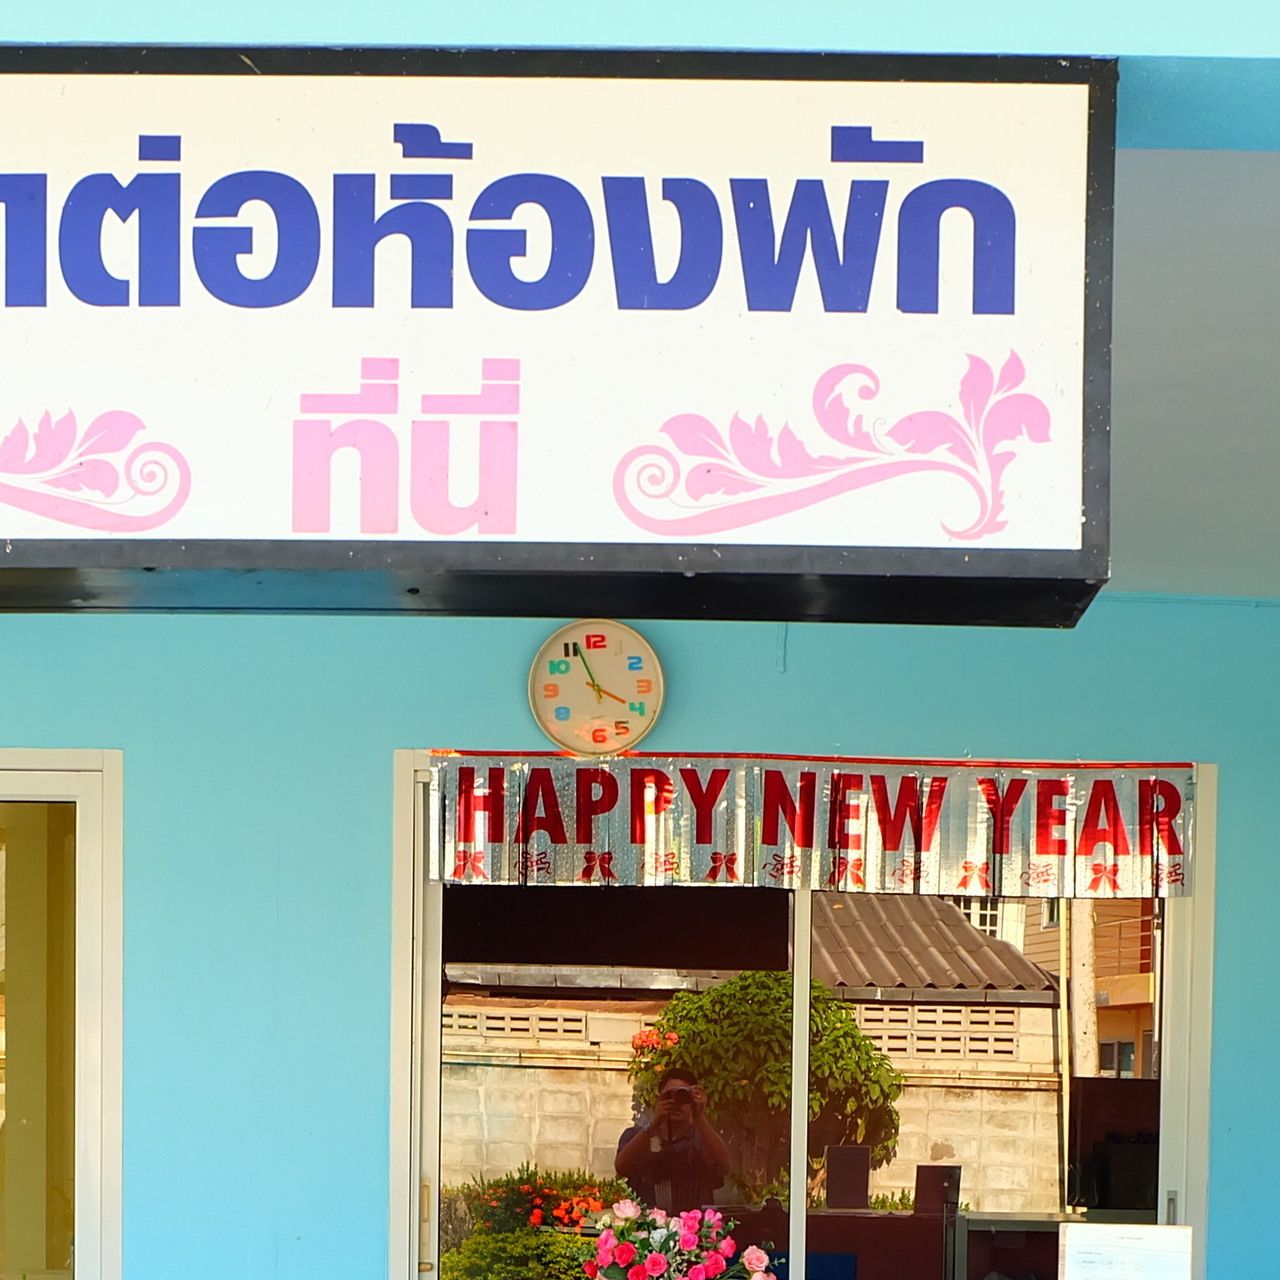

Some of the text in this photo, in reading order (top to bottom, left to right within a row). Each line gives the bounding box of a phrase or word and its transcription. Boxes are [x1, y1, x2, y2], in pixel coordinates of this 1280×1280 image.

[292, 357, 520, 535] ที่นี่
[585, 634, 607, 650] 12
[549, 660, 570, 675] 10
[627, 656, 643, 671] 2
[543, 683, 559, 698] 9
[636, 679, 652, 694] 3
[555, 706, 570, 721] 8
[629, 702, 645, 716] 4
[592, 728, 607, 743] 6
[614, 720, 630, 736] 5
[457, 766, 1182, 856] HAPPY NEW YEAR
